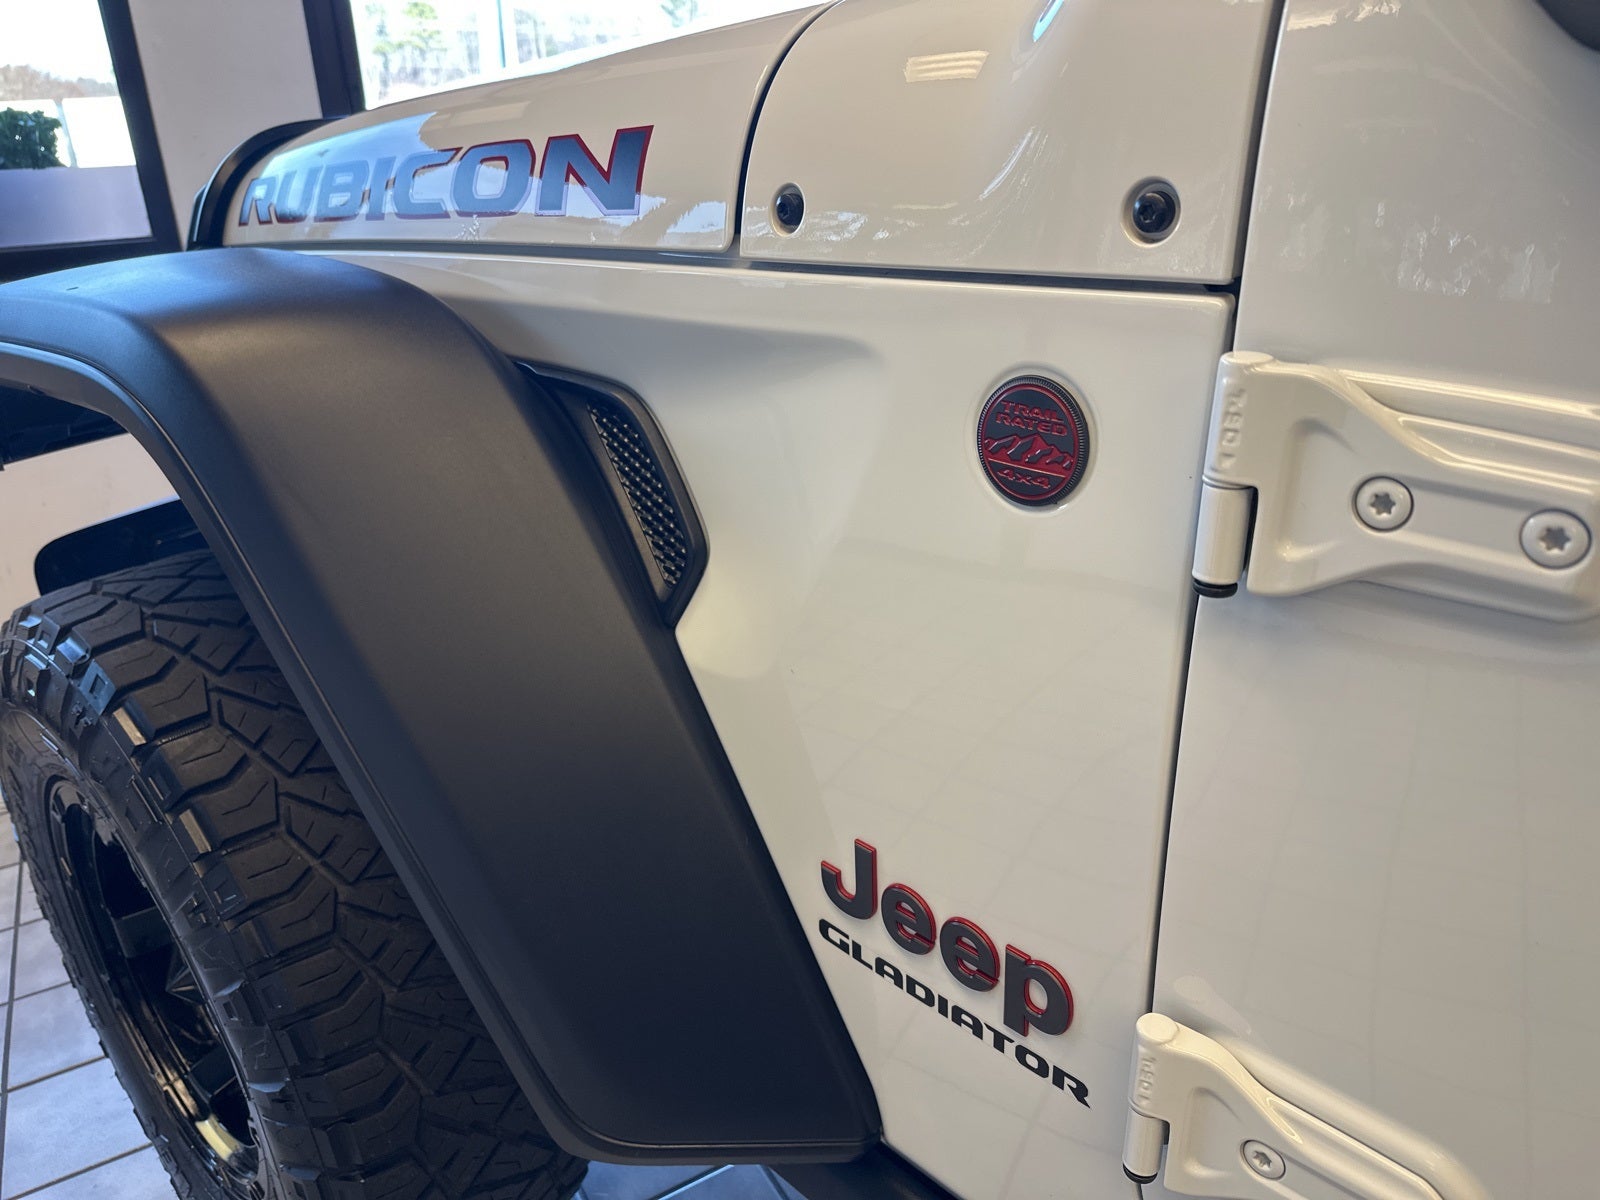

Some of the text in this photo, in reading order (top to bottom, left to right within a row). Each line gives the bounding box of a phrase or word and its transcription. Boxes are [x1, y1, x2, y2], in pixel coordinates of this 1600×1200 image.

[238, 125, 654, 227] RUBICON
[996, 412, 1068, 437] RATED
[1000, 401, 1065, 423] TRAIL
[820, 838, 1075, 1037] Jeep
[818, 918, 1092, 1109] GLADIATOR
